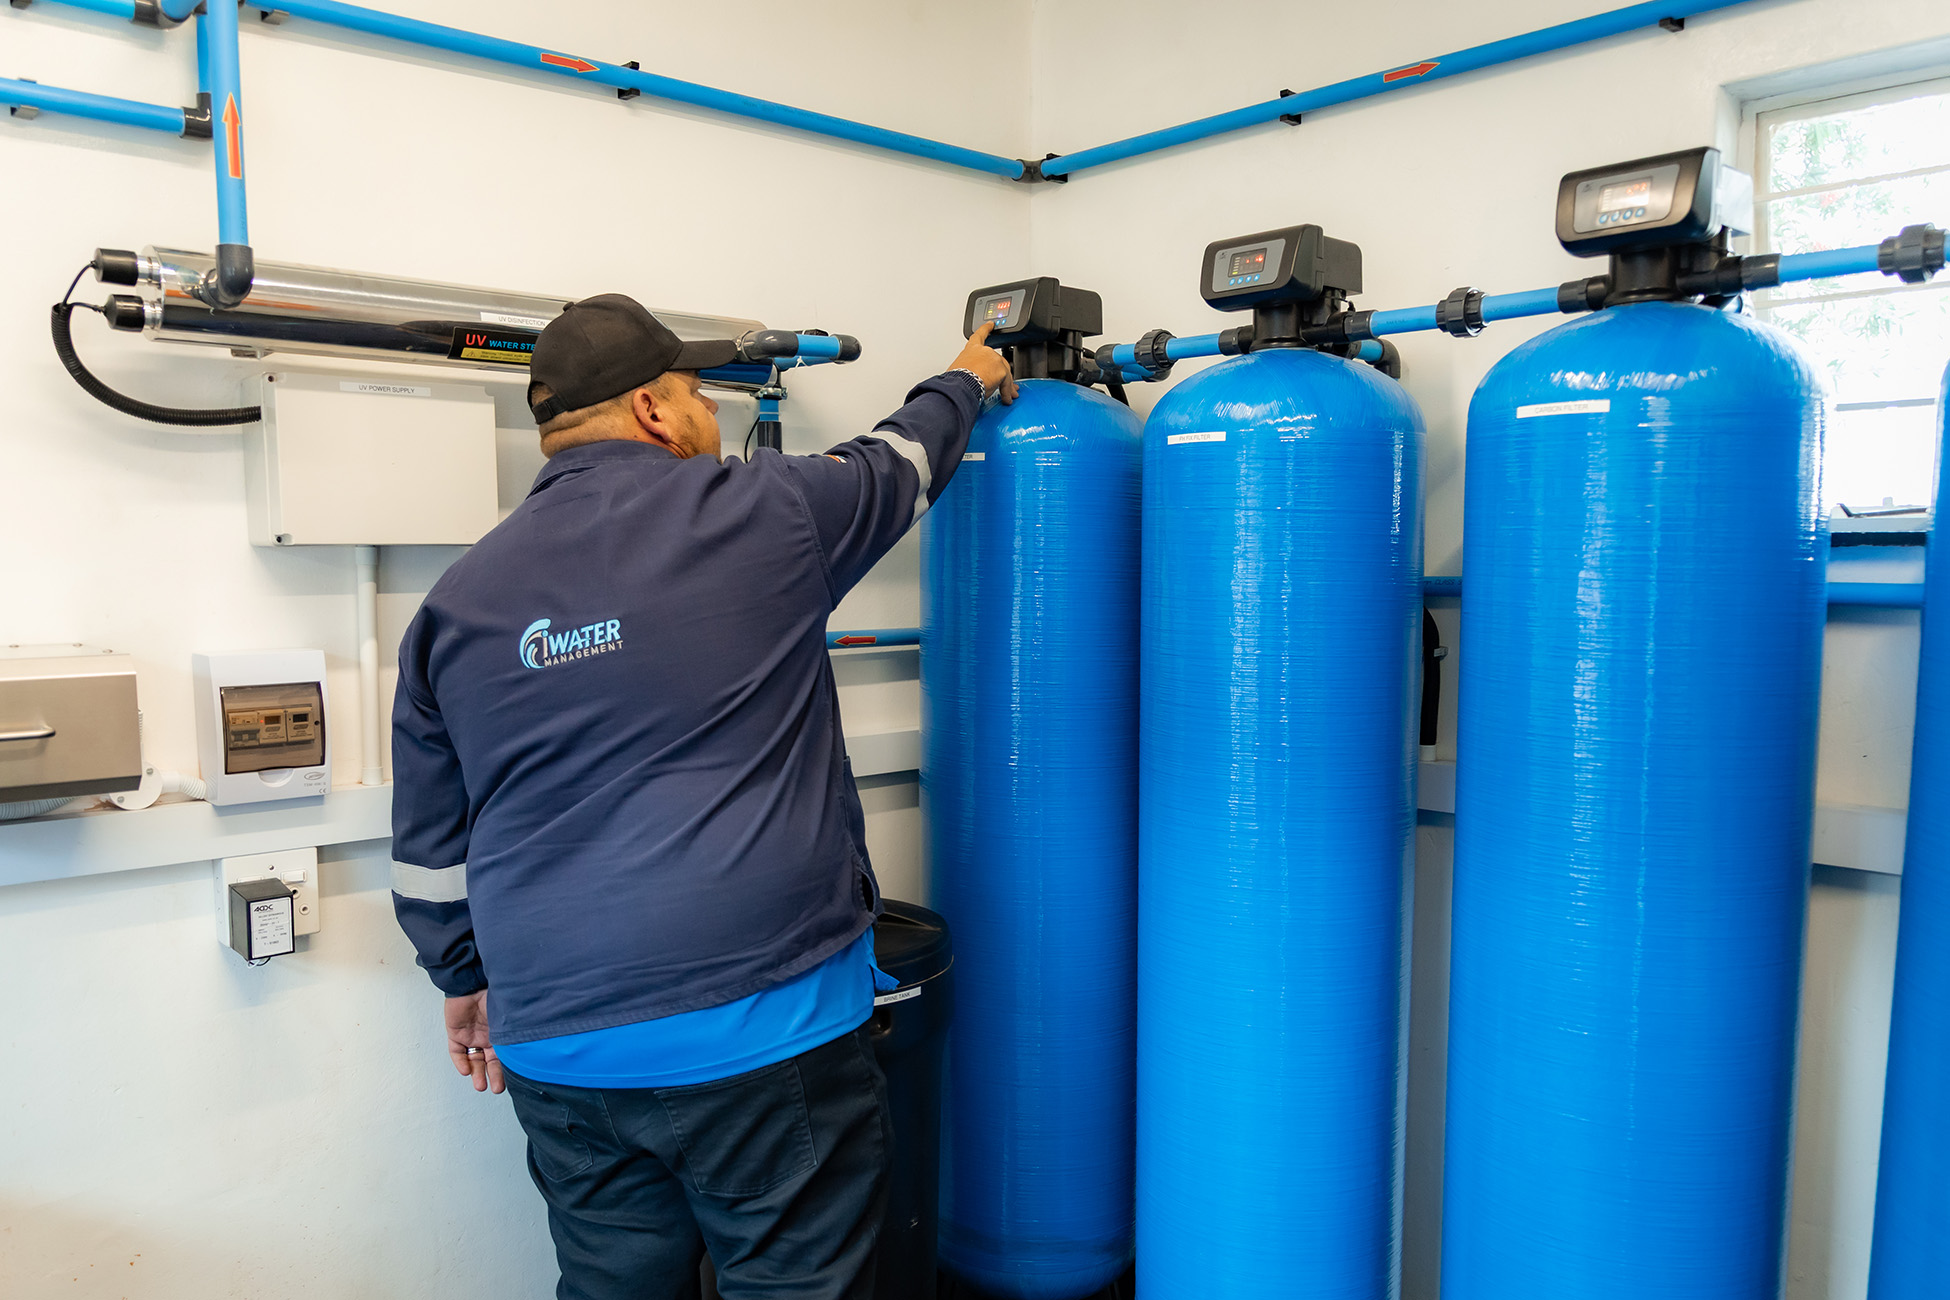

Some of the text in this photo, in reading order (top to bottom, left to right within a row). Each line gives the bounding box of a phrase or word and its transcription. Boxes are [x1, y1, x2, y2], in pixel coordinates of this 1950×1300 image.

[507, 317, 545, 326] DISINFECTION
[465, 334, 536, 352] UV WATER STE
[392, 386, 416, 394] SUPPLY
[1535, 404, 1589, 414] CARBON FILTER
[544, 640, 624, 667] MANAGEMENT
